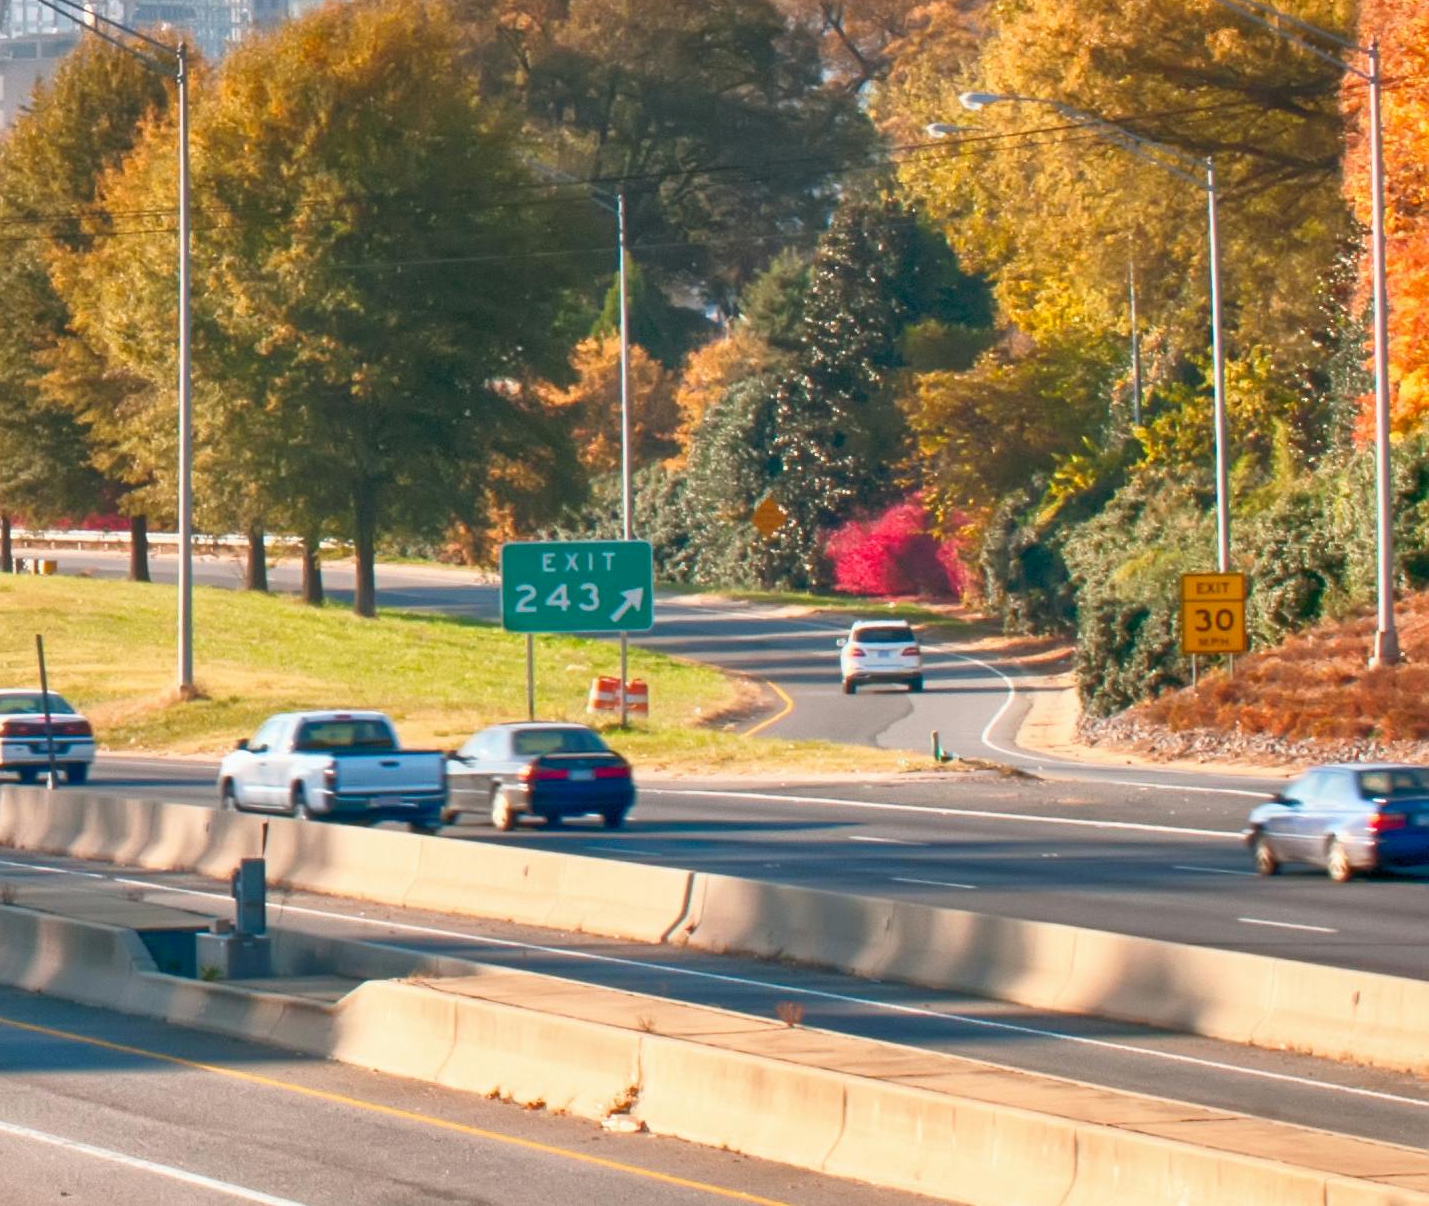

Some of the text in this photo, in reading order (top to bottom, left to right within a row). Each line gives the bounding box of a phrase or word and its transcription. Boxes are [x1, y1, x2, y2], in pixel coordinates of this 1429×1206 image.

[542, 552, 616, 572] EXIT
[514, 582, 600, 613] 243
[1196, 581, 1230, 594] EXIT
[1195, 609, 1234, 632] 30
[1198, 637, 1229, 646] MPH
